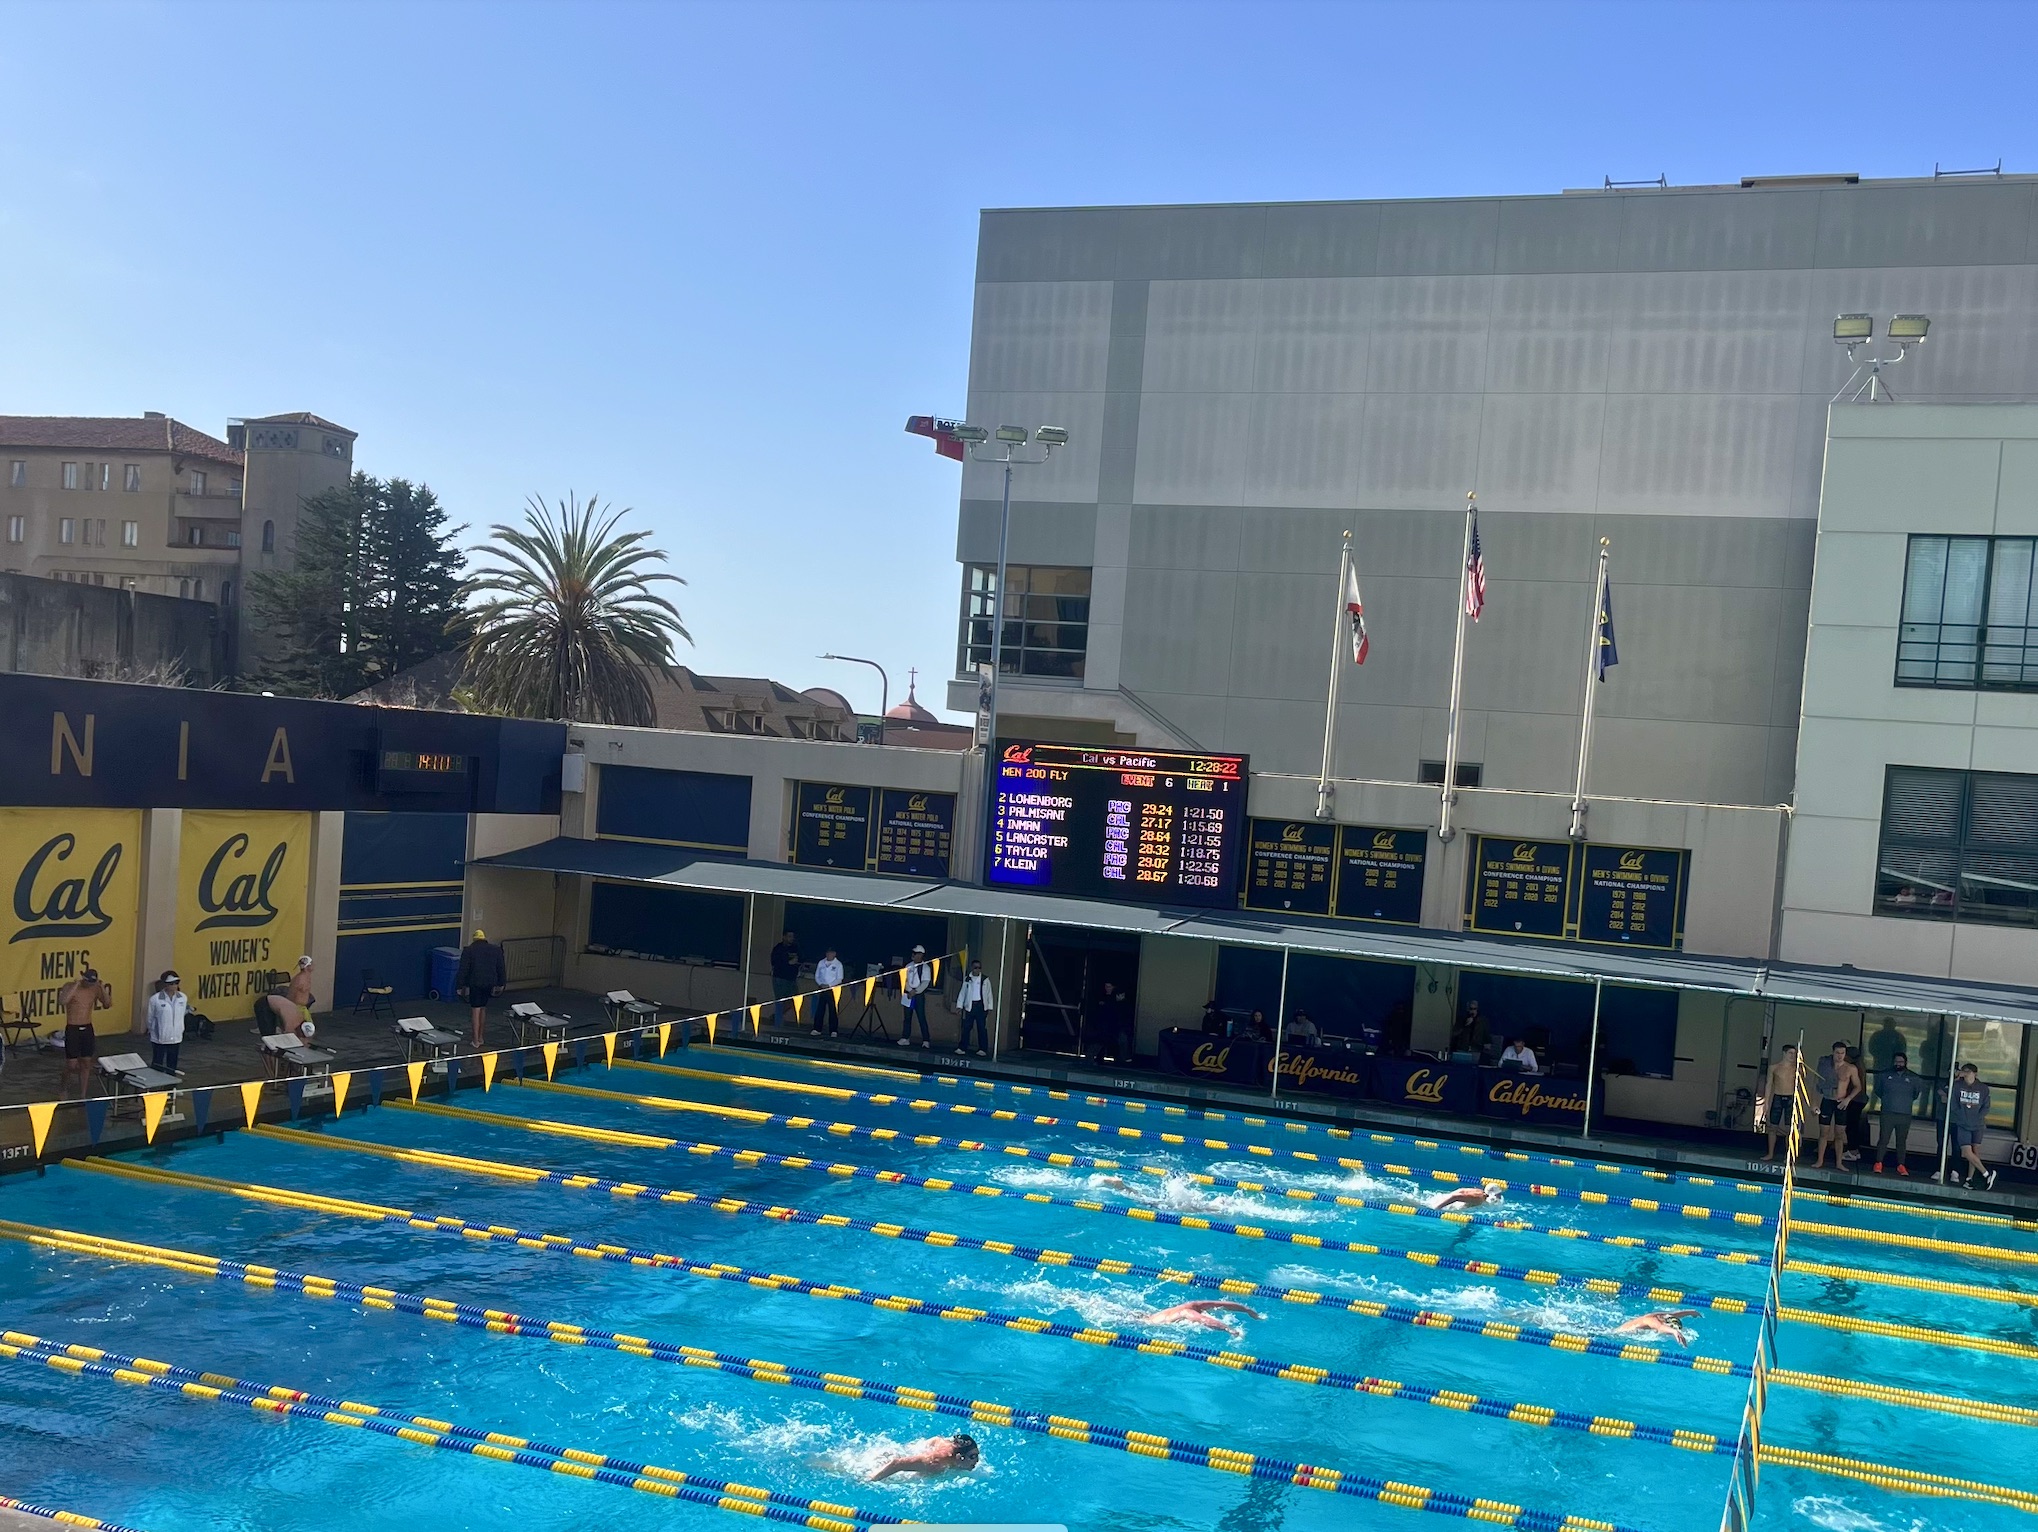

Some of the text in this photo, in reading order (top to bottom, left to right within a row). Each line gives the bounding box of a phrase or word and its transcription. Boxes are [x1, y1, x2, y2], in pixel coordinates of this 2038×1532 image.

[1003, 745, 1033, 763] Cal
[1082, 753, 1237, 773] Cal vs Pacific 12:28:22
[1002, 767, 1068, 780] MEN 200 FLY
[1121, 774, 1229, 791] EVENT 6 HEAT 1
[825, 787, 845, 804] Cal
[908, 794, 928, 811] Cal
[999, 792, 1224, 820] 2 LOWENBORG PAC 29.24 1:21.50
[802, 811, 865, 822] CONFERENCE CHAMPIONS
[889, 820, 944, 830] NATIONAL CHAMPIONS
[998, 806, 1223, 833] 3 PALMISANI CAL 27.17 1:15.69
[997, 819, 1221, 847] 4 INMAN PAC 28.64 1:21.55
[1282, 824, 1305, 842] Cal
[1372, 831, 1396, 849] Cal
[995, 831, 1220, 860] 5 LANCASTER CAL 28.32 1:18.75
[1255, 841, 1278, 850] WOMEN'S
[1344, 848, 1369, 858] WOMEN'S
[1370, 850, 1398, 860] SWIMMING
[1512, 843, 1537, 861] Cal
[995, 844, 1219, 873] 6 TAYLOR PAC 29.07 1:22.56
[1255, 851, 1329, 862] CONFERENCE CHAMPIONS
[1349, 859, 1415, 870] NATIONAL CHAMPIONS
[1619, 851, 1645, 870] Cal
[994, 857, 1218, 887] 7 KLEIN CAL 28.67 1:20.68
[1483, 871, 1562, 883] CONFERENCE CHAMPIONS
[1487, 861, 1504, 870] MEN'S
[1505, 863, 1535, 873] SWIMMING
[1542, 865, 1560, 875] DIVING
[1592, 869, 1611, 879] MEN'S
[1612, 871, 1642, 881] SWIMMING
[1650, 874, 1669, 883] DIVING
[8, 832, 122, 945] Cal
[194, 832, 287, 933] Cal
[1594, 880, 1665, 891] NATIONAL CHAMPIONS
[210, 938, 270, 966] WOMEN'S
[41, 950, 90, 980] MEN'S
[198, 972, 240, 1000] WATER
[1192, 1042, 1230, 1073] Cal
[1268, 1052, 1360, 1085] California
[1404, 1069, 1448, 1102] Cal
[1489, 1080, 1586, 1115] California
[2013, 1144, 2037, 1167] 69
